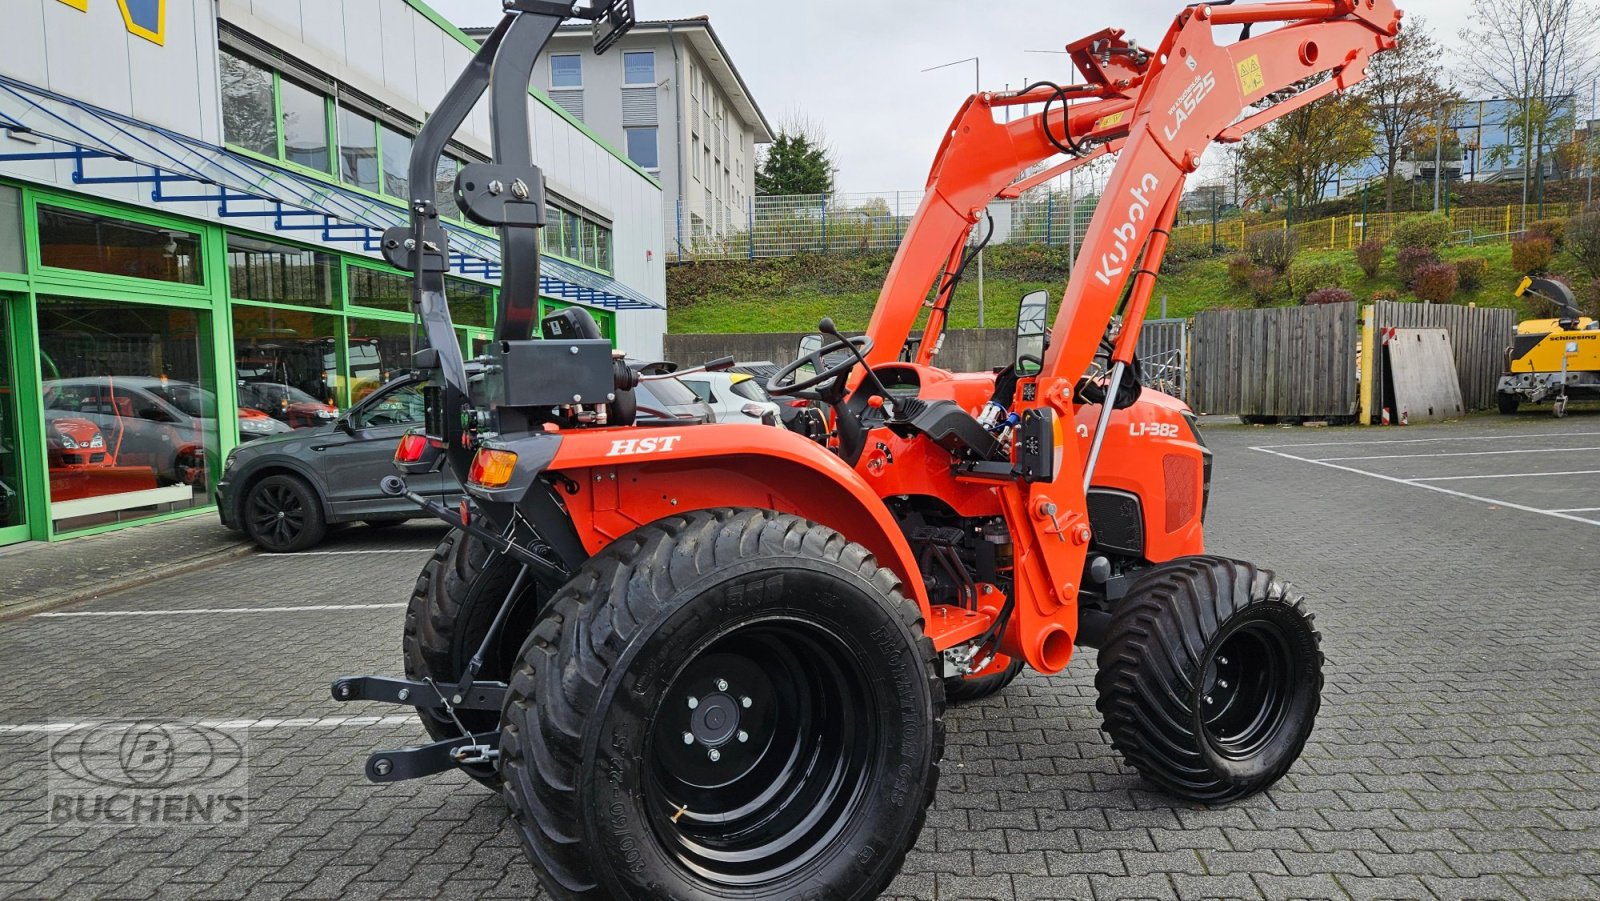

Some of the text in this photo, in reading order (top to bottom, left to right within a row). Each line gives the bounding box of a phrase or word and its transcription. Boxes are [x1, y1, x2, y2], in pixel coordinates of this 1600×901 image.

[1164, 70, 1216, 141] LA525
[1095, 173, 1159, 285] Kubota
[605, 435, 682, 457] HST
[1129, 422, 1179, 438] L1-382
